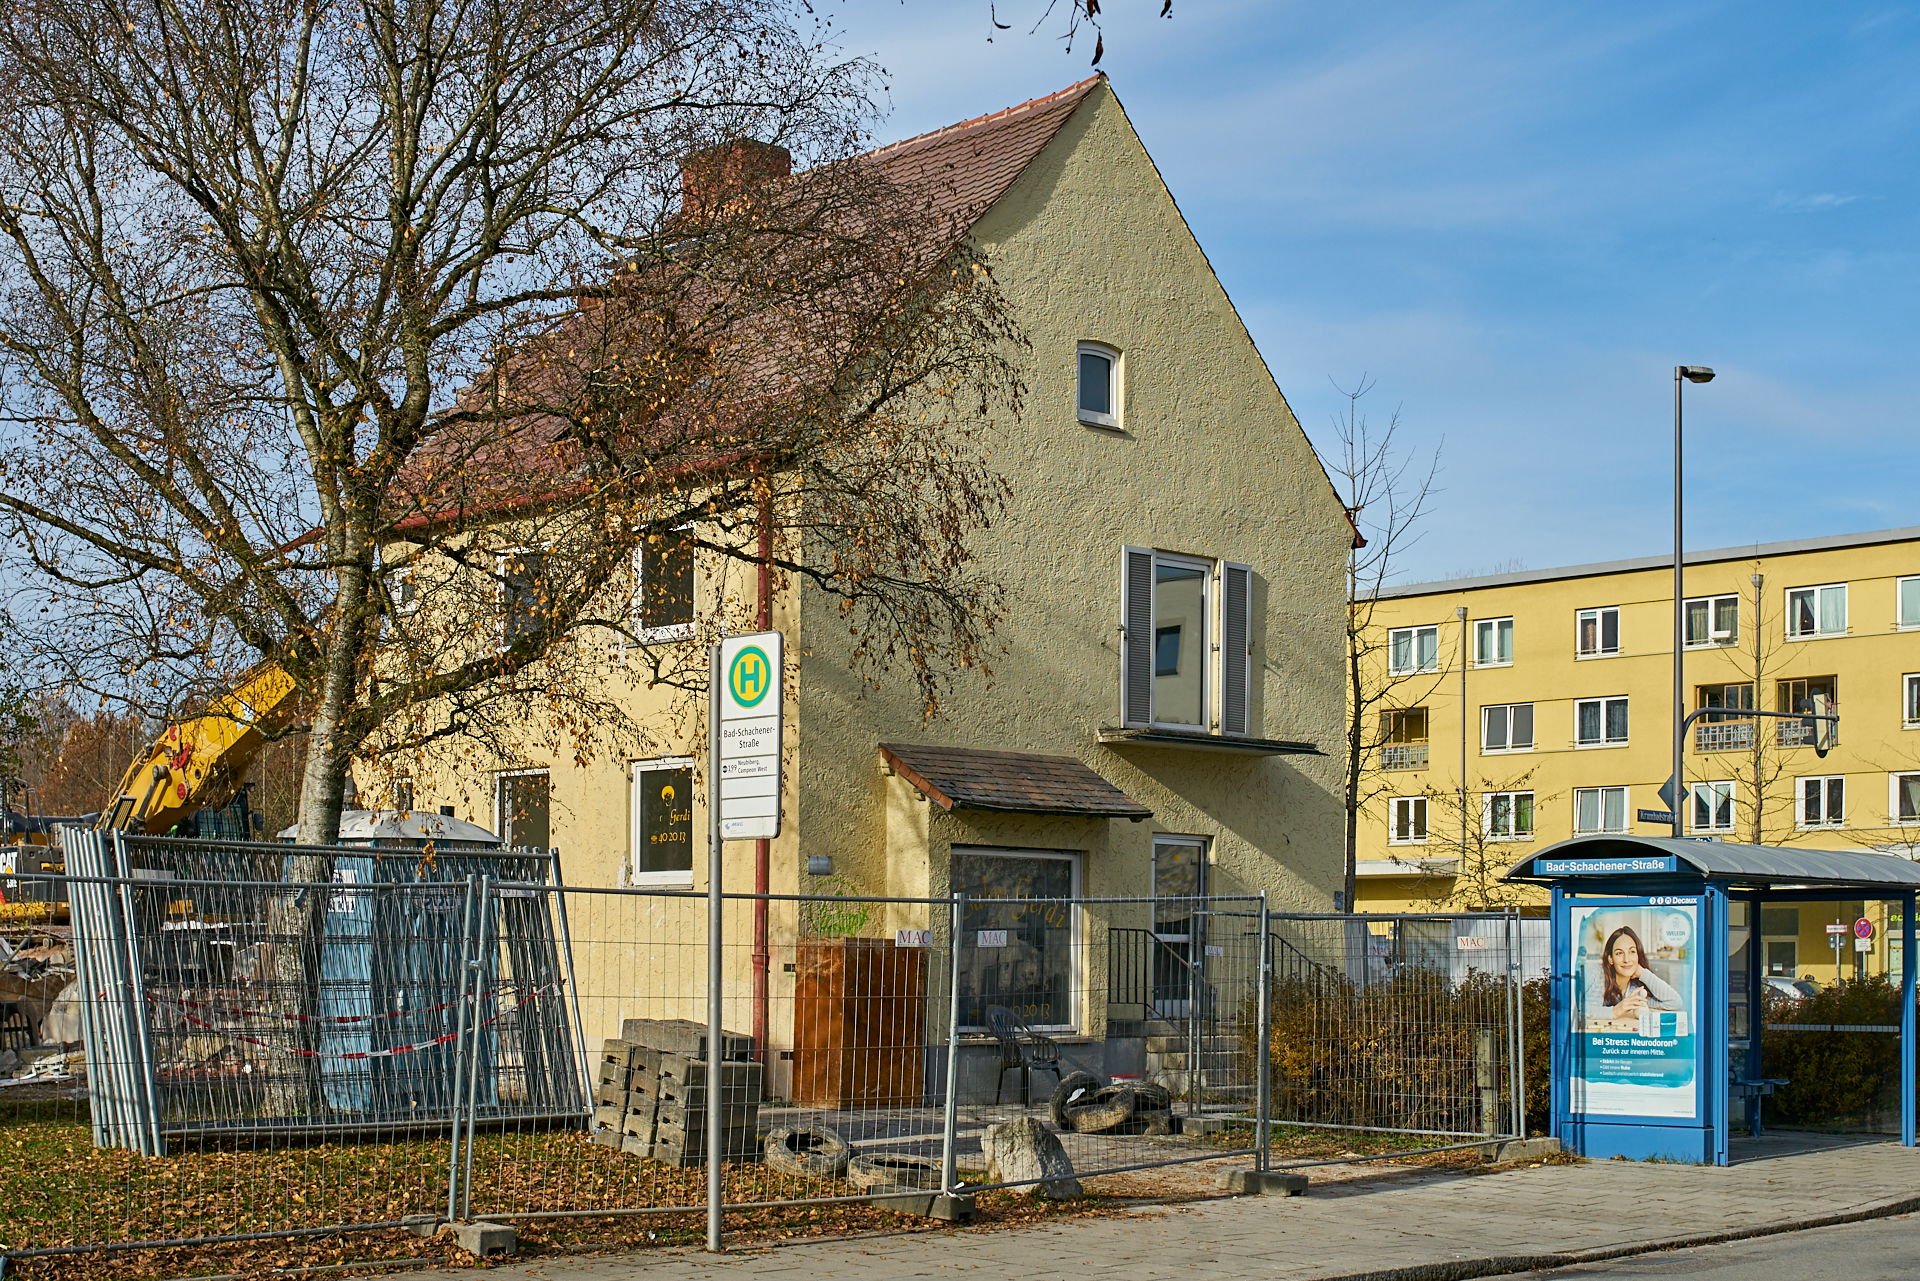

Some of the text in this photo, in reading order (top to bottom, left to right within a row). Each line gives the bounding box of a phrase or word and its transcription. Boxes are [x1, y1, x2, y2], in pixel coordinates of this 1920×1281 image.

[740, 660, 760, 693] H
[723, 726, 776, 738] Bad-Schachener-
[739, 738, 760, 749] Straße
[669, 808, 691, 826] Gerdi
[658, 831, 686, 844] 40 20 13
[0, 851, 18, 874] CAT
[1546, 859, 1665, 872] Bad-Schachener-Straße
[1011, 877, 1068, 928] Gerdi
[1672, 897, 1697, 905] Decaux
[899, 930, 930, 945] MAC
[981, 931, 1006, 945] MAC
[1459, 937, 1484, 948] MAC
[1023, 1004, 1038, 1017] 20
[1040, 1003, 1050, 1020] 13
[1592, 1037, 1604, 1046] Bei
[1605, 1037, 1630, 1047] Stress:
[1602, 1047, 1620, 1055] Zurück
[1630, 1048, 1650, 1056] inneren
[1650, 1048, 1666, 1056] Mitte.
